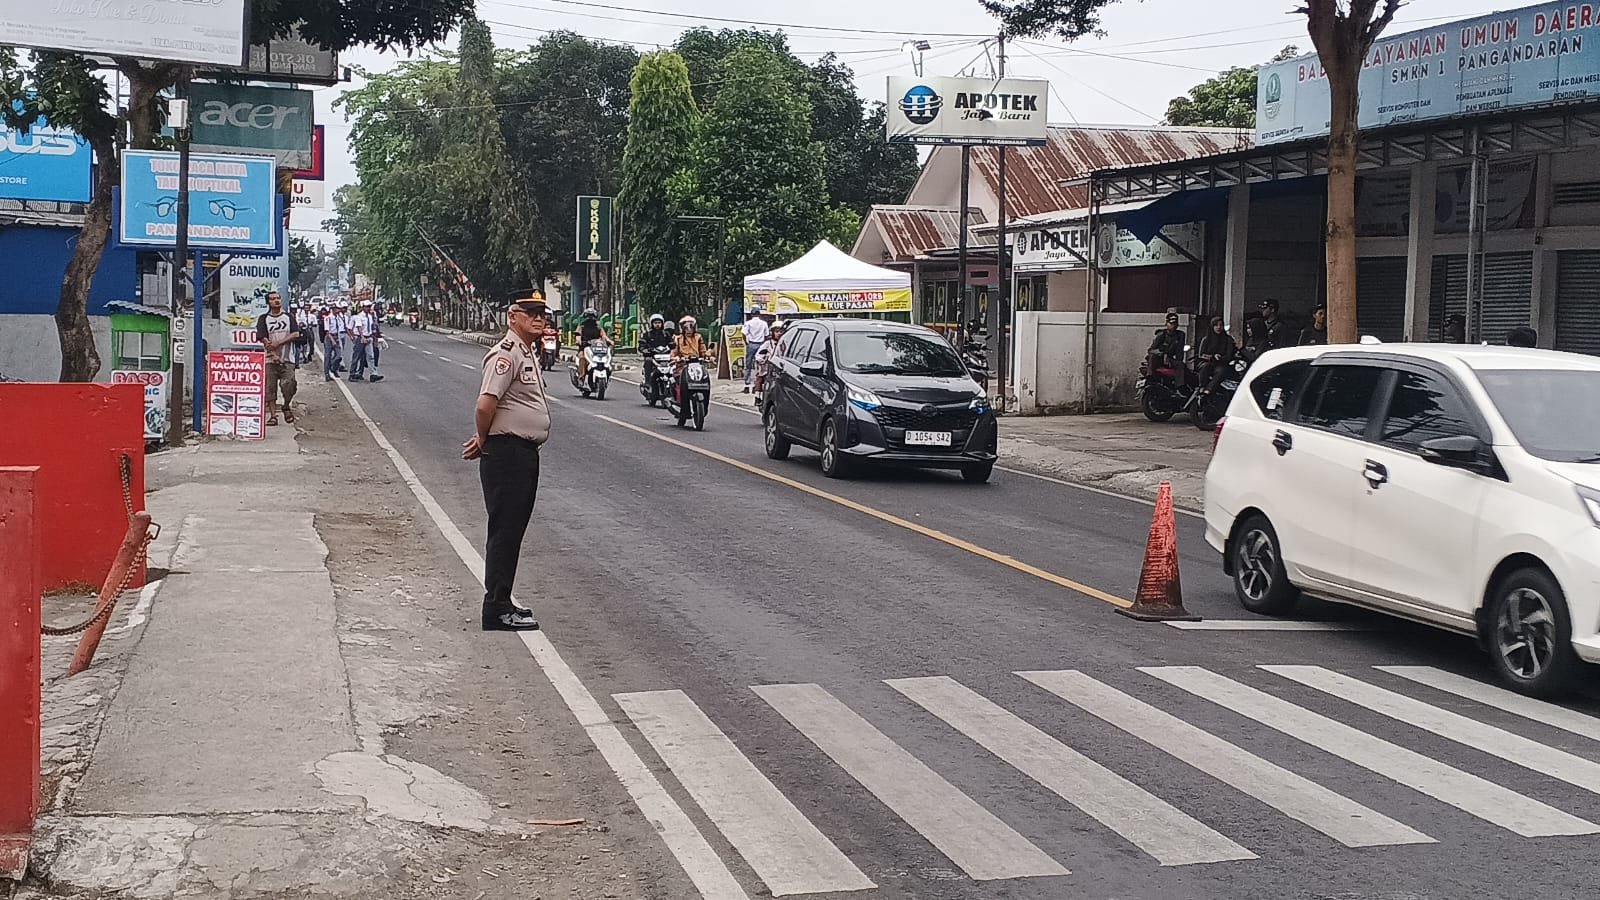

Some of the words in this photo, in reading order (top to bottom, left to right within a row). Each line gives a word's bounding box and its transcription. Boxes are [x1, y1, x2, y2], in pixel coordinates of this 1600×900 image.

[1461, 19, 1518, 49] UMUM
[1391, 63, 1429, 84] SMKN
[1439, 60, 1445, 75] 1
[1458, 35, 1583, 72] PANGANDARAN
[954, 92, 1038, 111] APOTEK
[199, 100, 300, 129] acer
[0, 177, 28, 185] STORE
[147, 223, 250, 239] PANANDARAN
[229, 264, 280, 279] BANDUNG
[809, 293, 849, 302] SARAPAN
[828, 302, 845, 310] KUE
[846, 302, 874, 310] PASAR
[211, 370, 261, 384] TAUFIQ
